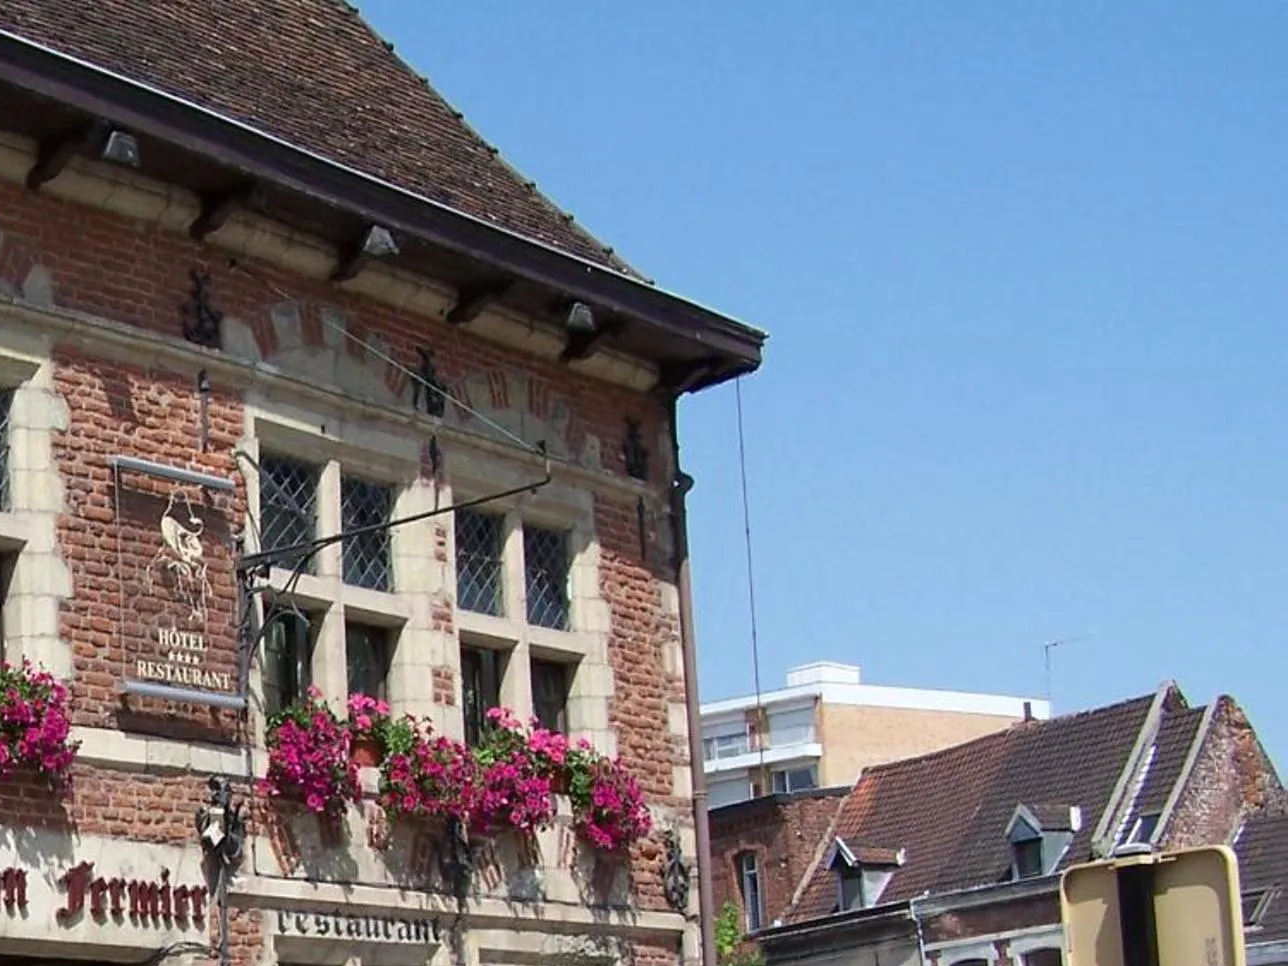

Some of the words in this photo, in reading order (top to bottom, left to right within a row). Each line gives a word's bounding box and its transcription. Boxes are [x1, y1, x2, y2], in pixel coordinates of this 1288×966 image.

[136, 660, 231, 690] RESTAURANT
[56, 860, 209, 924] Fermier
[277, 909, 441, 942] restaurant
